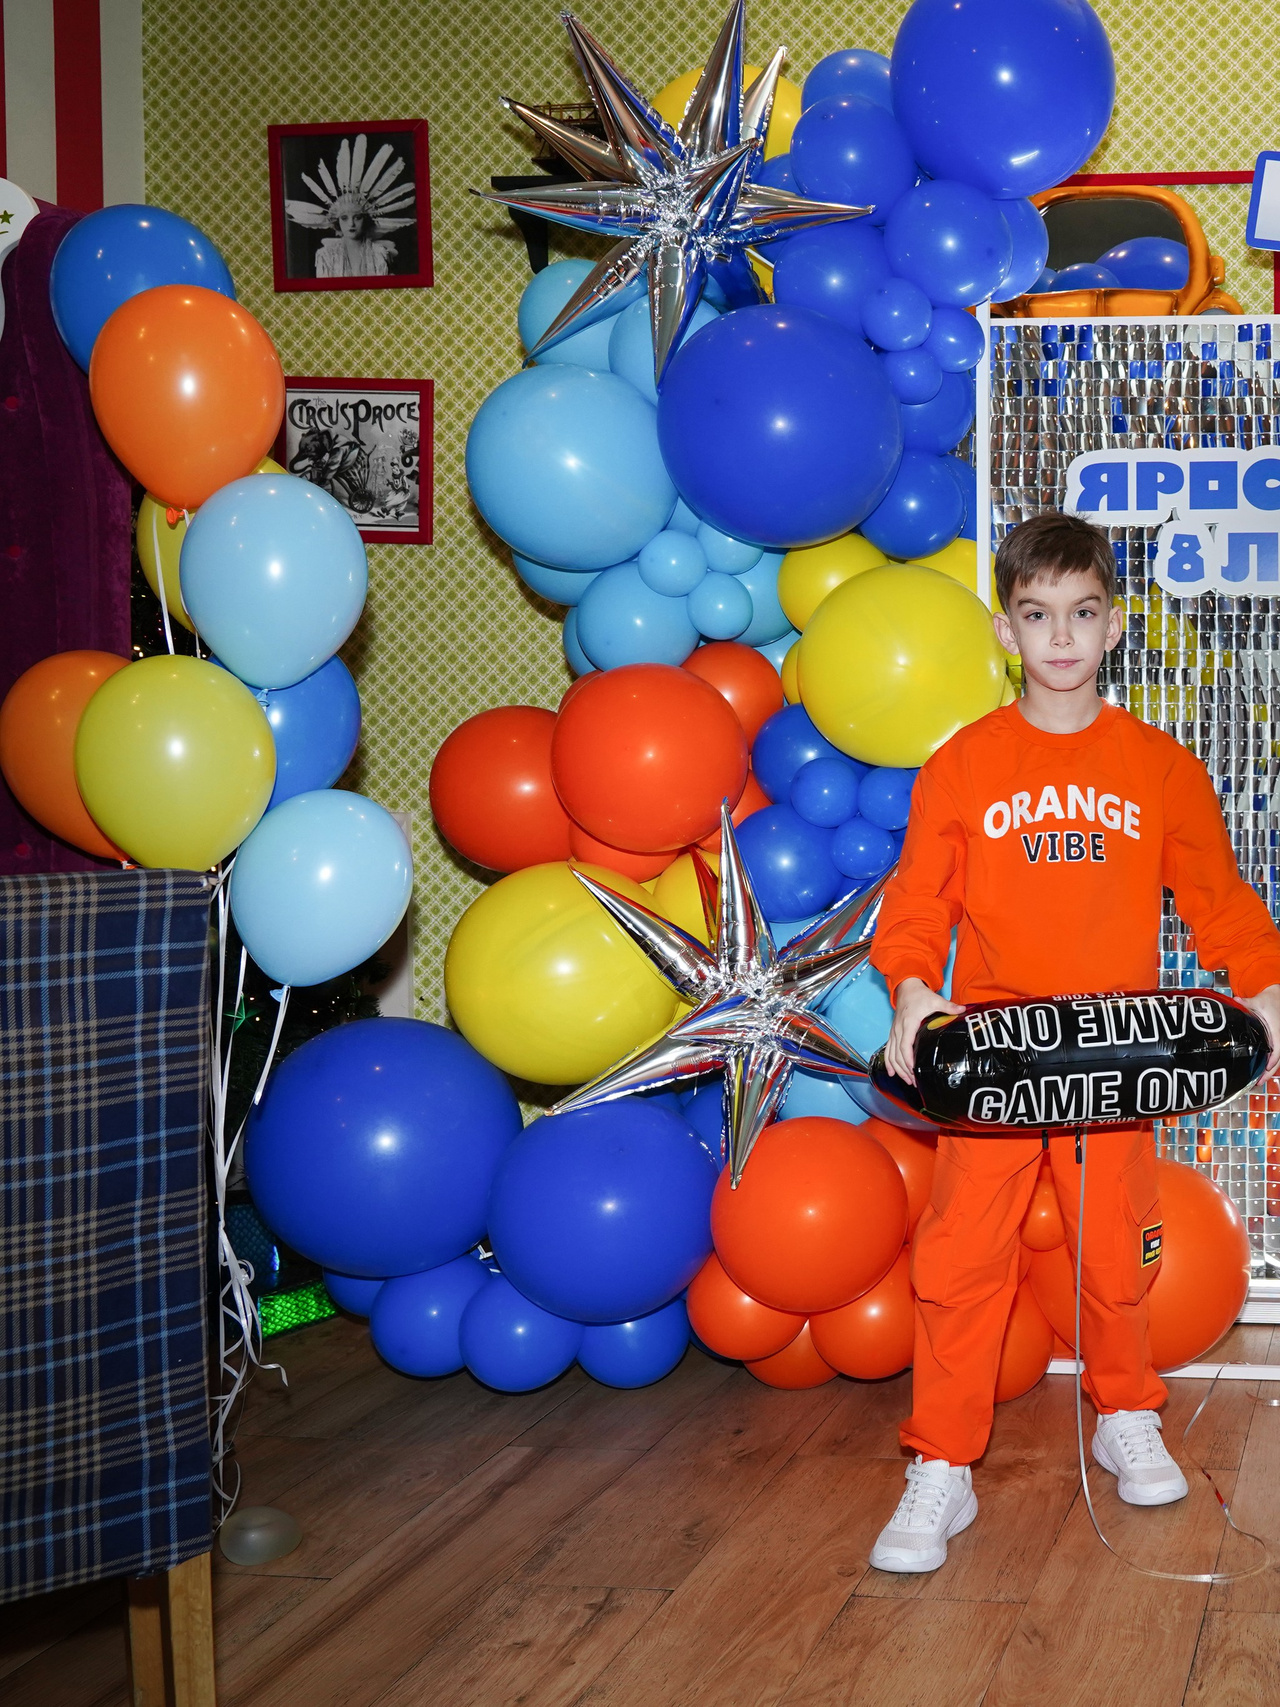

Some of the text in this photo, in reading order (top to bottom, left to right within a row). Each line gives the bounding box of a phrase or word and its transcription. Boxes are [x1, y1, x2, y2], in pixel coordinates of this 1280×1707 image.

[348, 399, 420, 446] PROCE
[1167, 532, 1205, 584] 8
[983, 784, 1141, 840] ORANGE
[1020, 831, 1106, 863] VIBE
[964, 995, 1227, 1053] GAME ON!
[967, 1067, 1229, 1126] GAME ON!
